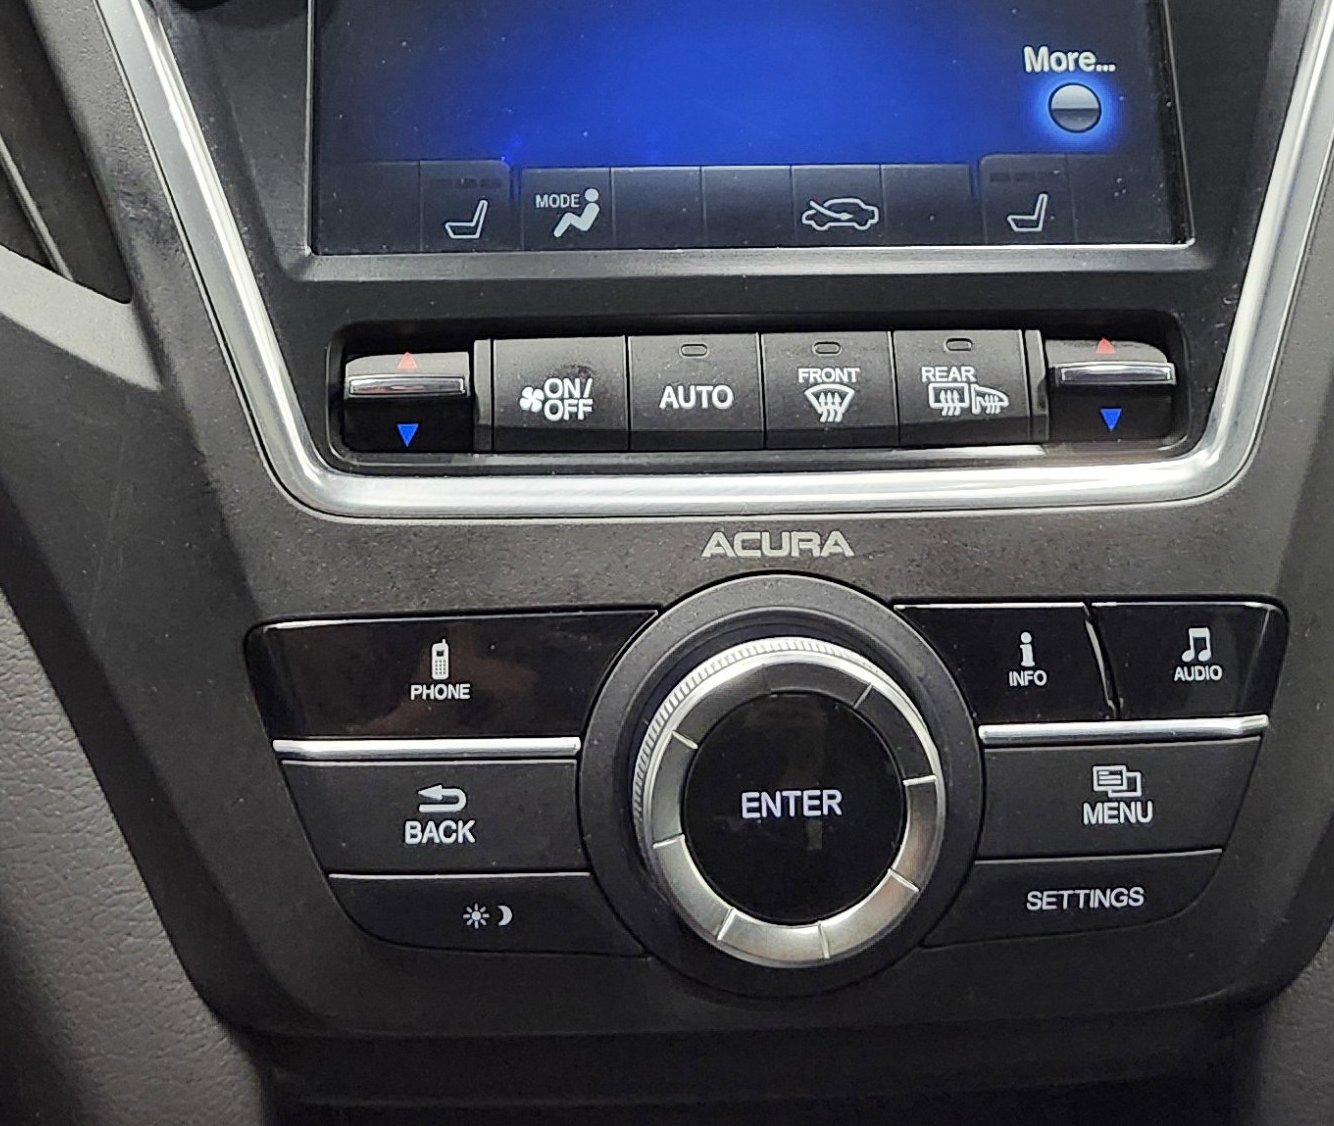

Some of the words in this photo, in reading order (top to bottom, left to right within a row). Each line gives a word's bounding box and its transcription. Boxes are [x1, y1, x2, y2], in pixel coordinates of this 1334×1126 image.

[1024, 46, 1116, 73] More...
[535, 194, 580, 208] MODE
[798, 368, 859, 383] FRONT
[922, 366, 976, 382] REAR
[544, 377, 592, 400] ON/
[660, 386, 734, 410] AUTO
[544, 399, 594, 422] OFF
[701, 531, 854, 558] ACURA
[1009, 670, 1047, 686] INFO
[1174, 665, 1222, 682] AUDIO
[410, 684, 470, 701] PHONE
[741, 790, 843, 819] ENTER
[1082, 801, 1153, 825] MENU
[404, 820, 476, 845] BACK
[1026, 886, 1145, 910] SETTINGS
